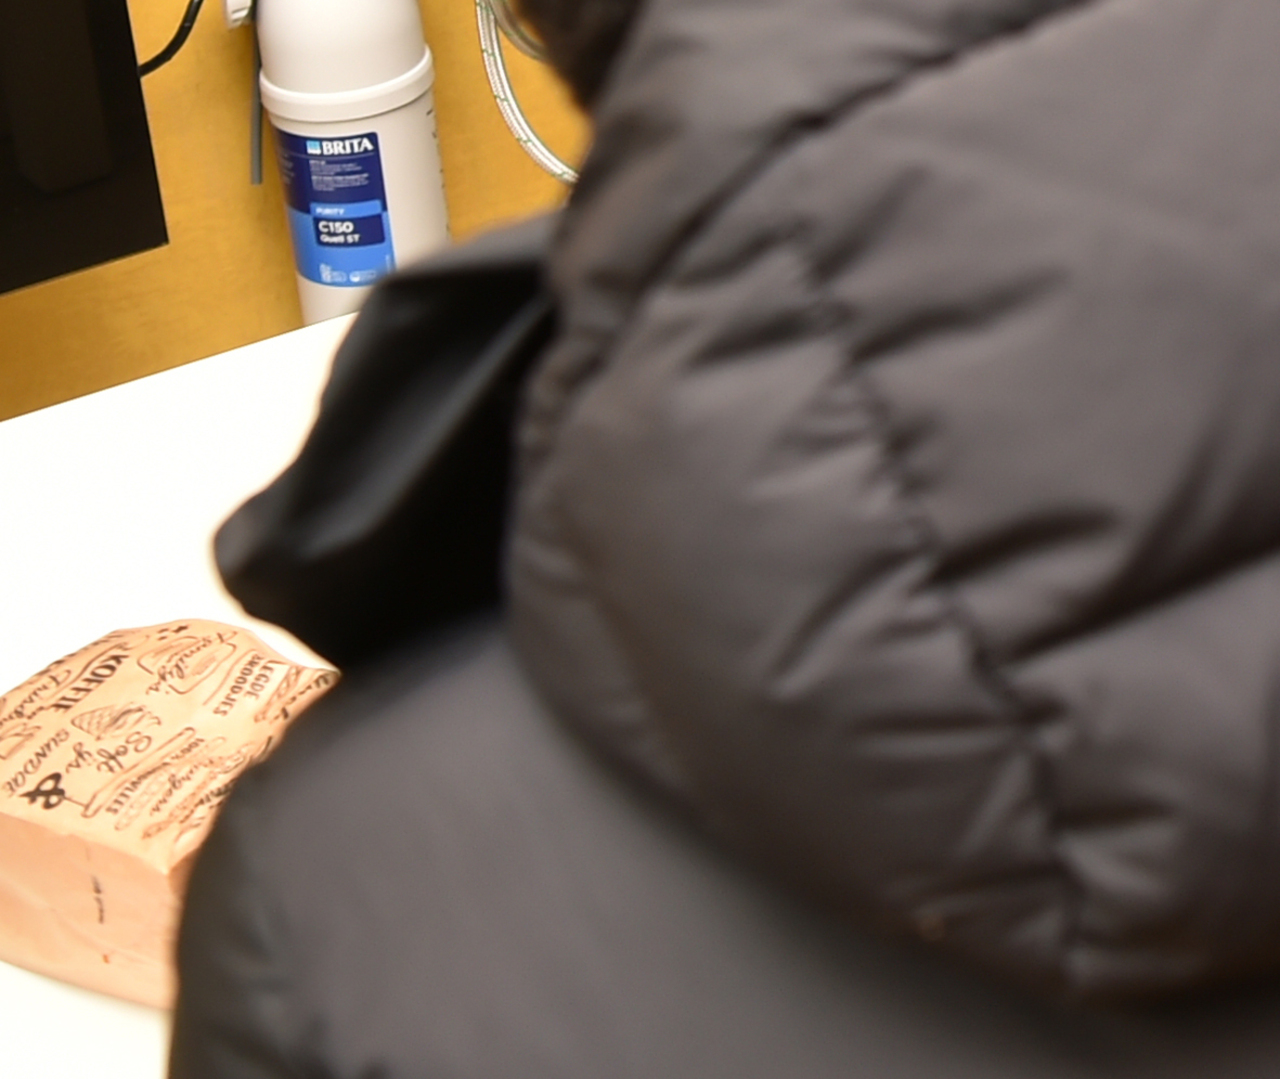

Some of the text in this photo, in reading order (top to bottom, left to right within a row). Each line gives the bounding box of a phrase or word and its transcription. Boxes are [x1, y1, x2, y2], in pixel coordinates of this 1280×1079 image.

[322, 137, 374, 155] BRITA
[316, 207, 345, 215] PURITY
[318, 220, 355, 234] C150
[49, 654, 130, 715] KOFFIE
[96, 731, 153, 774] Soft
